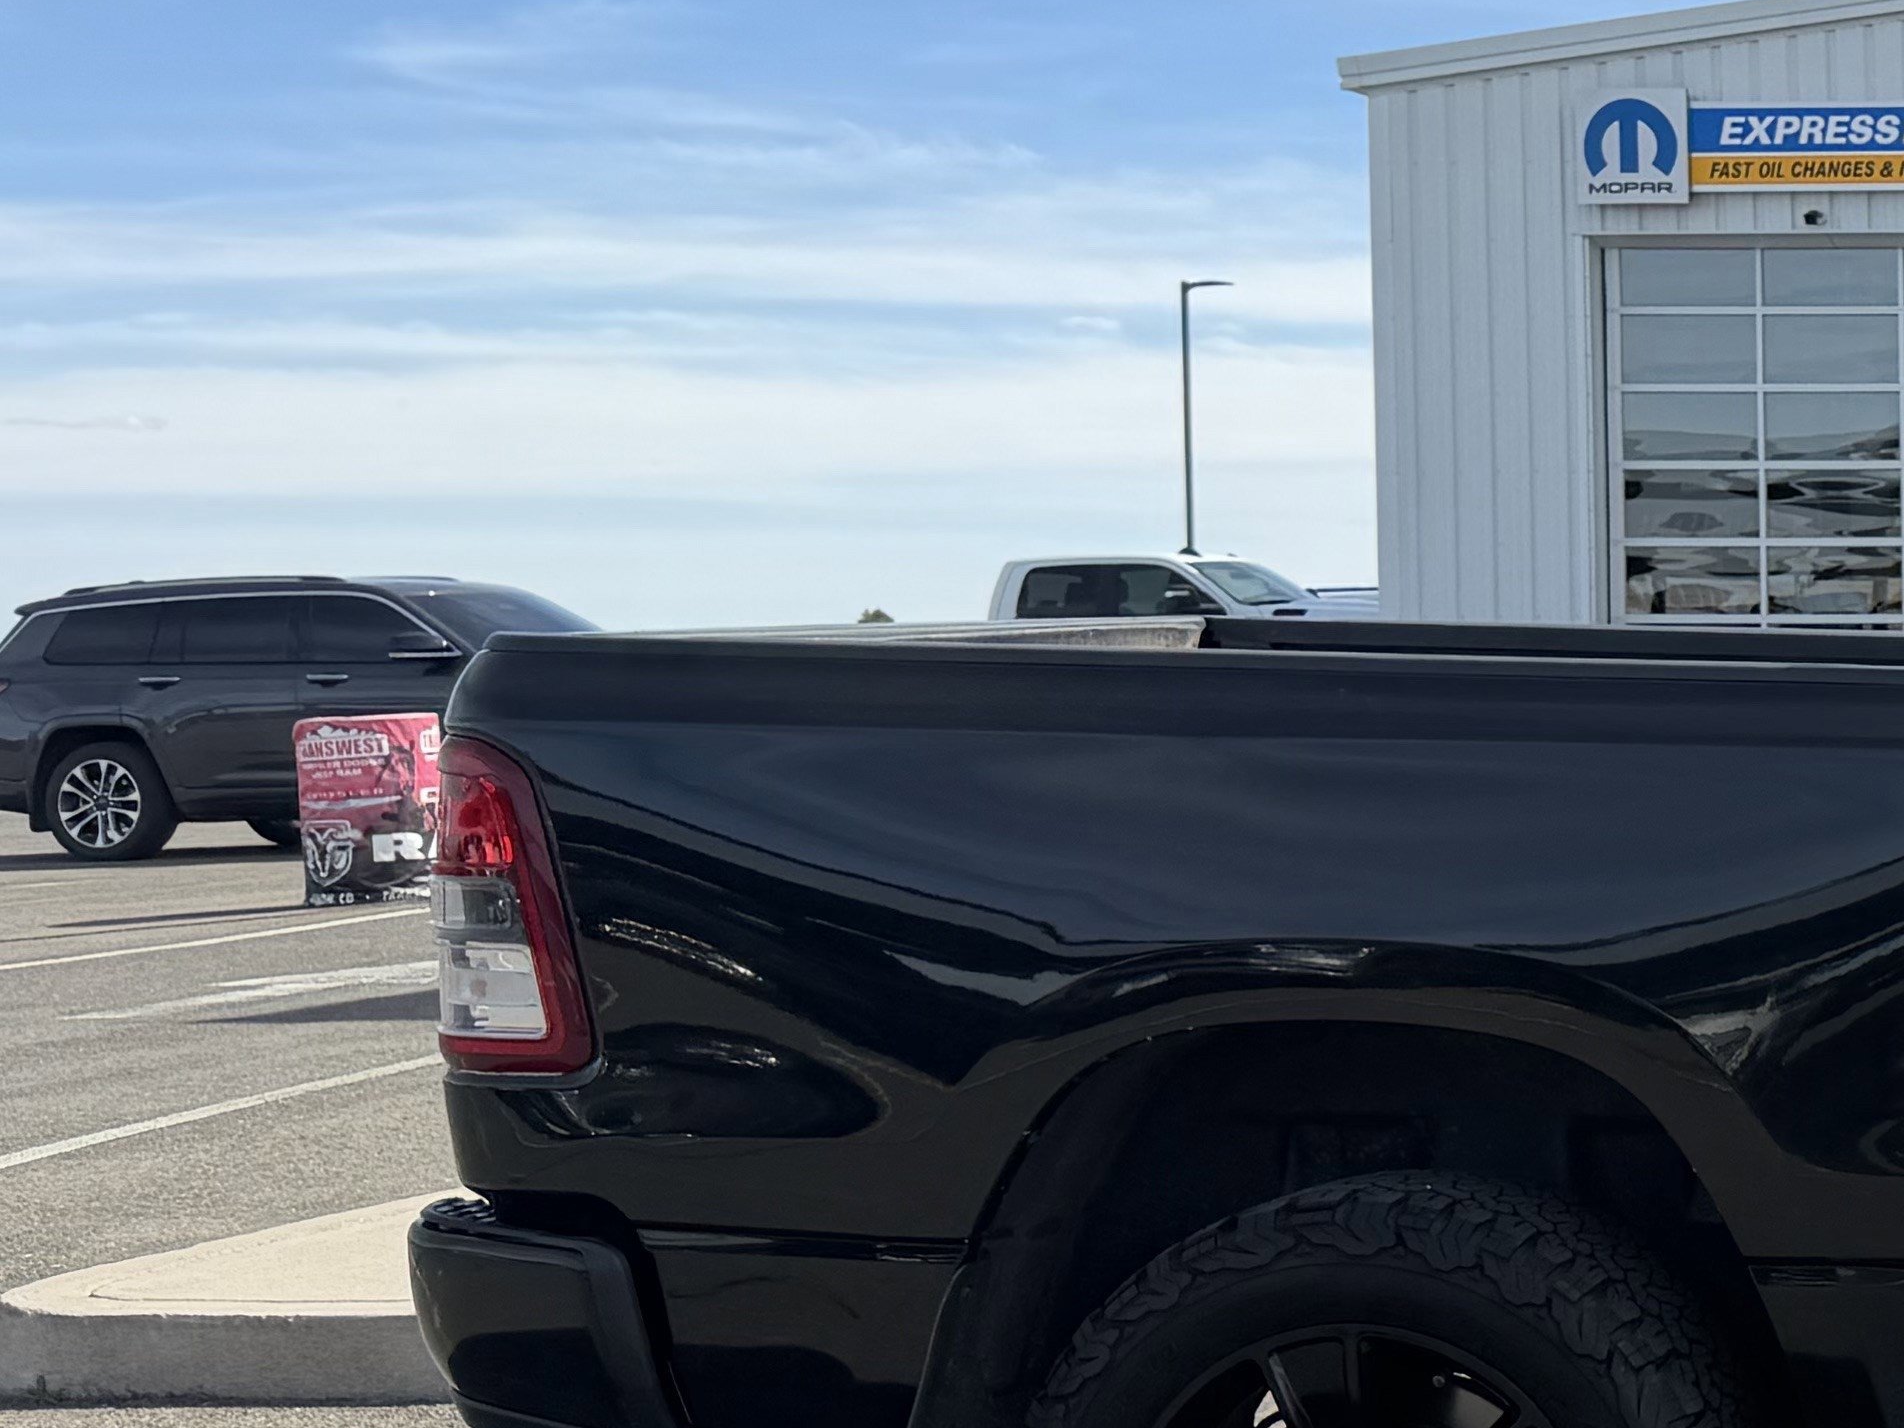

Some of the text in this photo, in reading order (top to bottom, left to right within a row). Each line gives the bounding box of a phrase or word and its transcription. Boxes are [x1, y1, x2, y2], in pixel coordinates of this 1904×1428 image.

[1709, 161, 1757, 179] FAST
[1758, 161, 1785, 179] OIL
[1791, 160, 1875, 179] CHANGES
[1879, 160, 1894, 178] &
[1588, 182, 1674, 195] MOPAR
